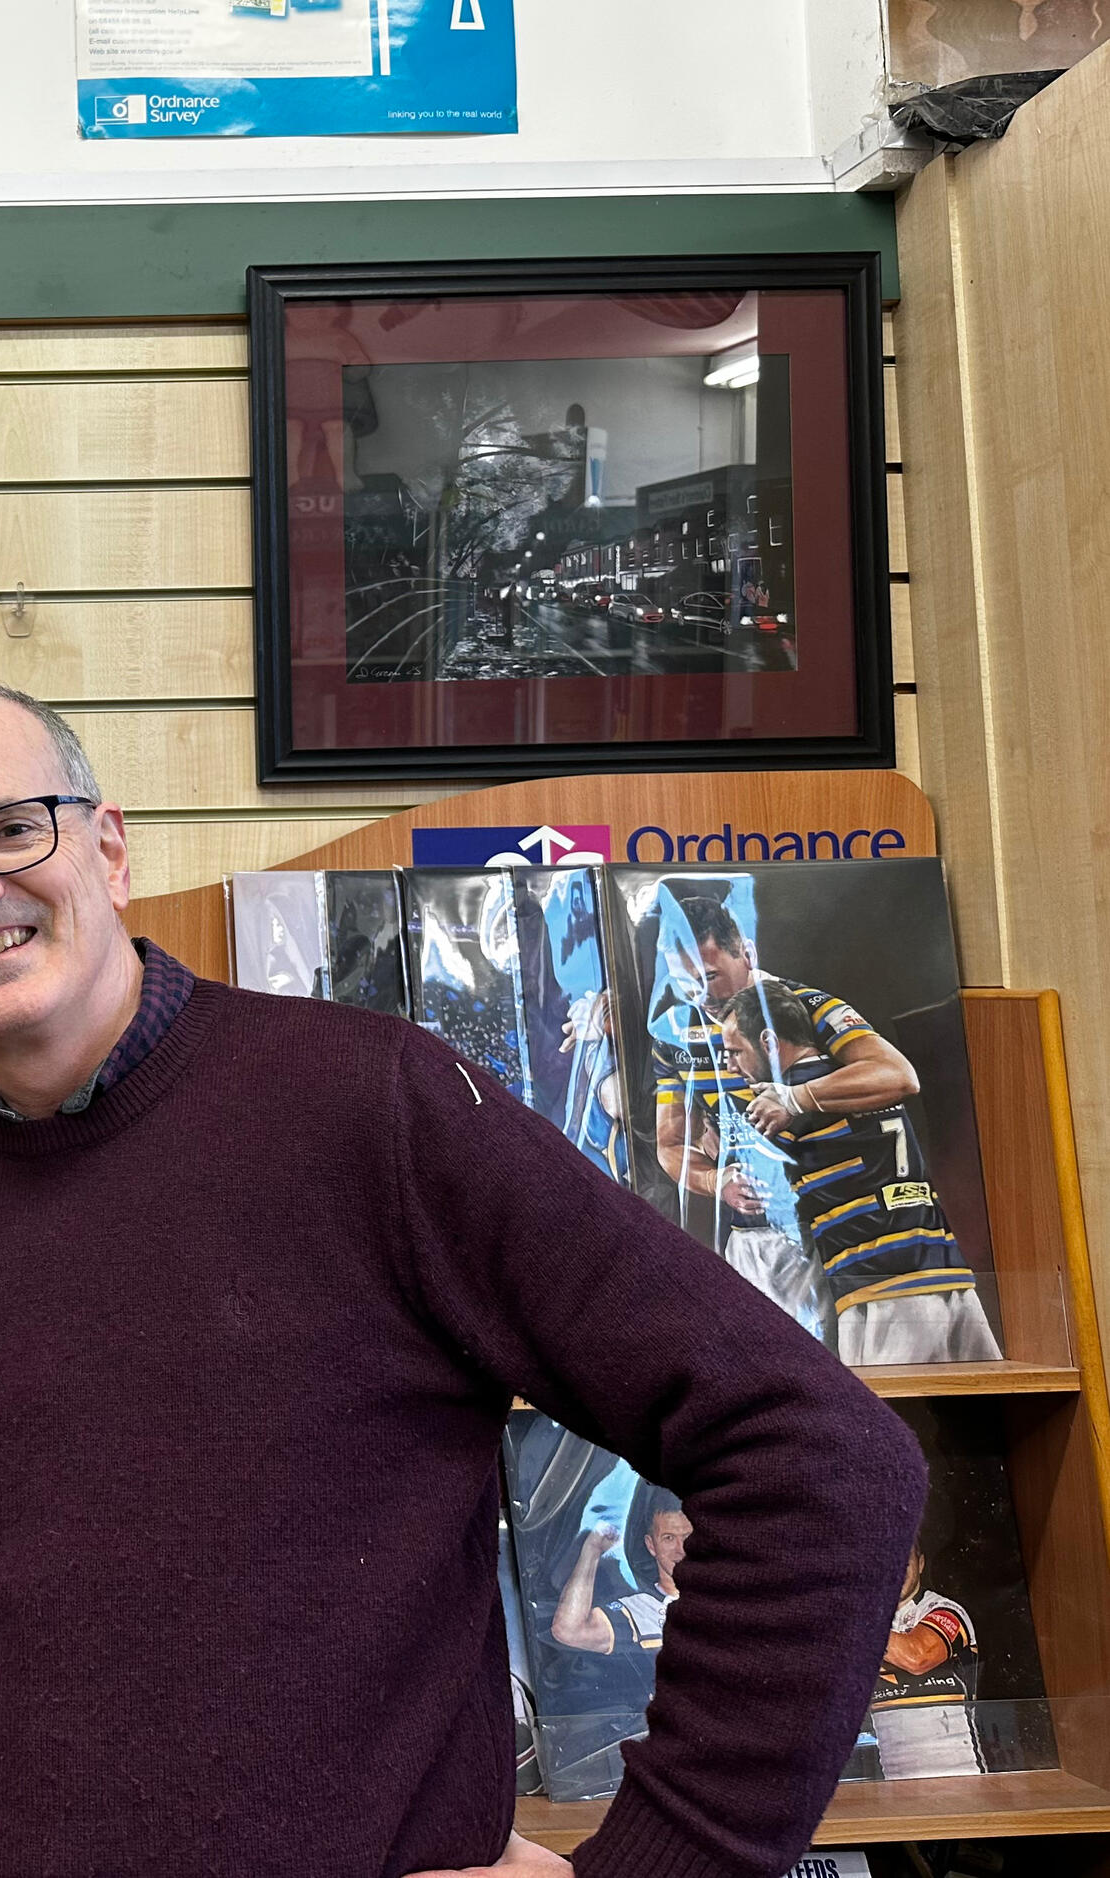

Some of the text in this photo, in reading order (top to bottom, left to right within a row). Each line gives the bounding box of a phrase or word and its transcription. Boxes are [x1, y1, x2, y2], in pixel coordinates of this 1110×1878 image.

[149, 95, 220, 108] Ordnance
[388, 110, 503, 120] linking you to the real world
[626, 823, 905, 862] Ordnance
[879, 1117, 910, 1178] 7
